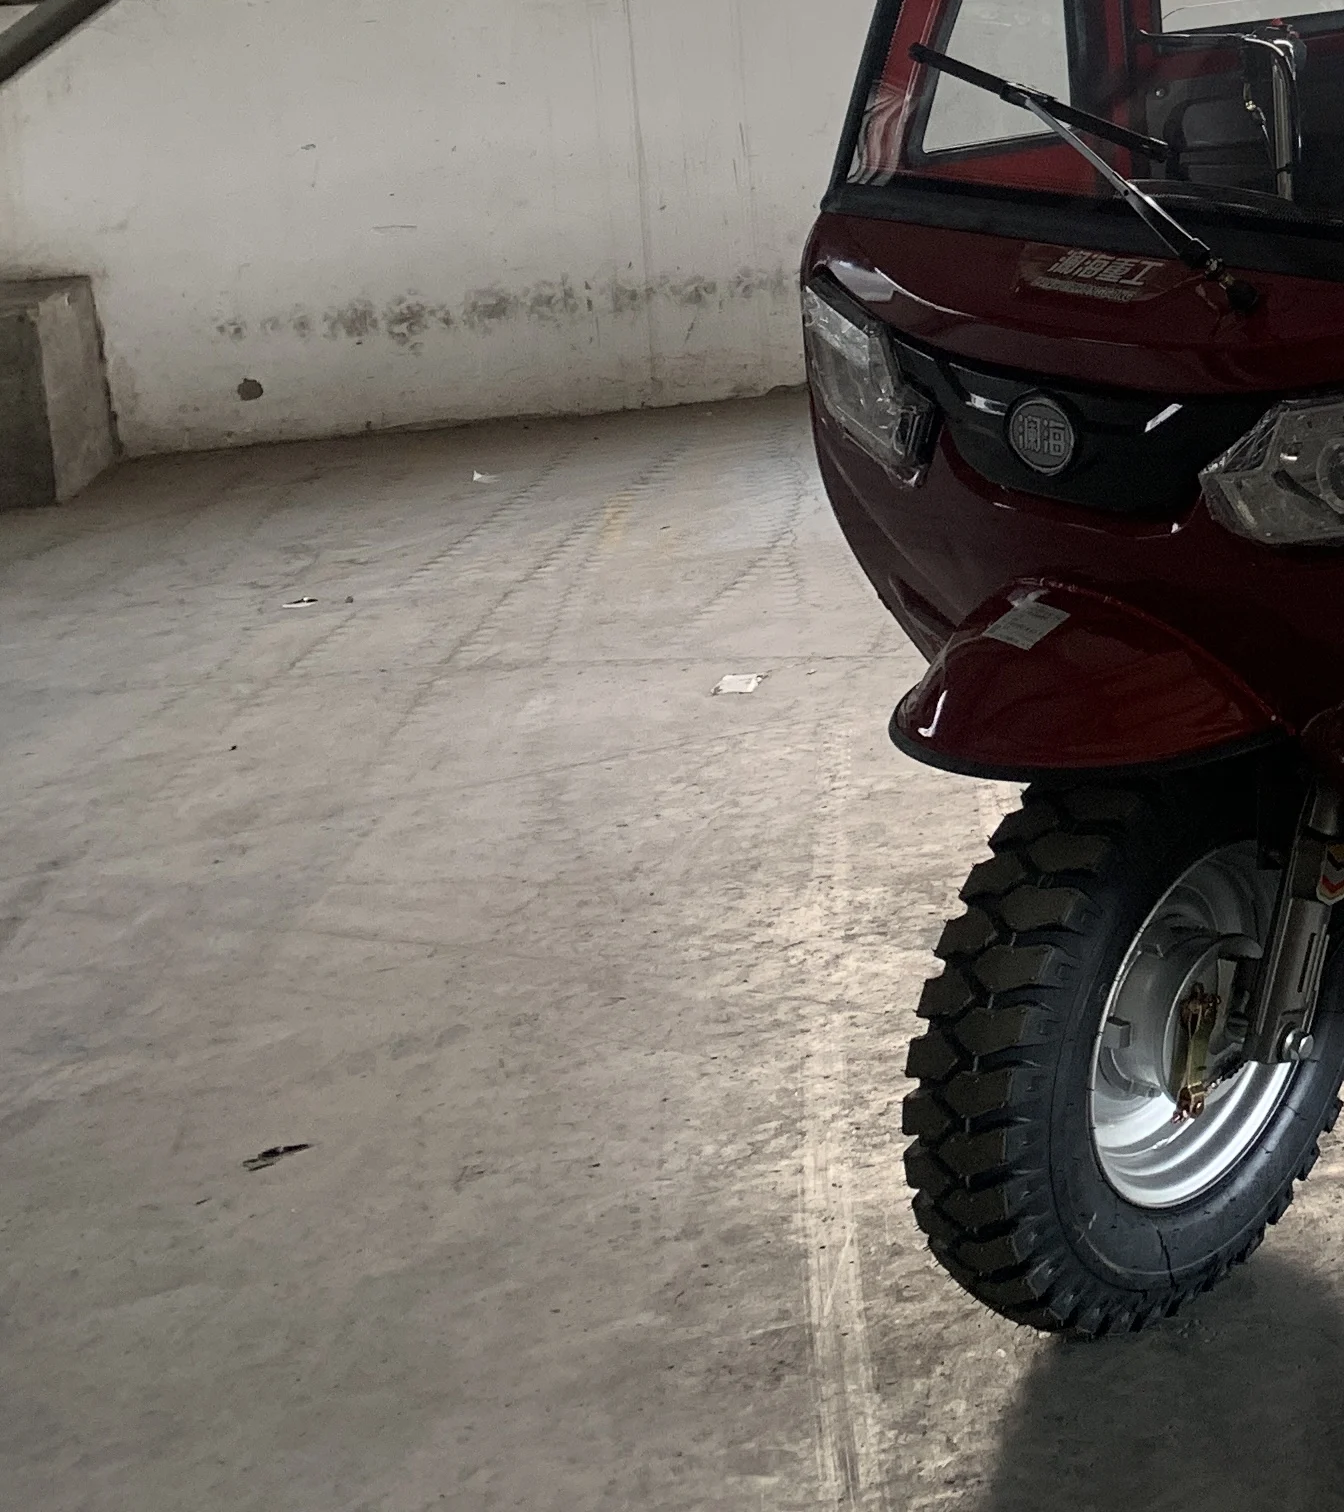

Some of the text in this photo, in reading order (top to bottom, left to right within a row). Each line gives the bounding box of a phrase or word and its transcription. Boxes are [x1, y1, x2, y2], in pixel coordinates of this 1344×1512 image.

[1046, 249, 1166, 286] 澜海重工
[1017, 413, 1066, 457] 澜海
